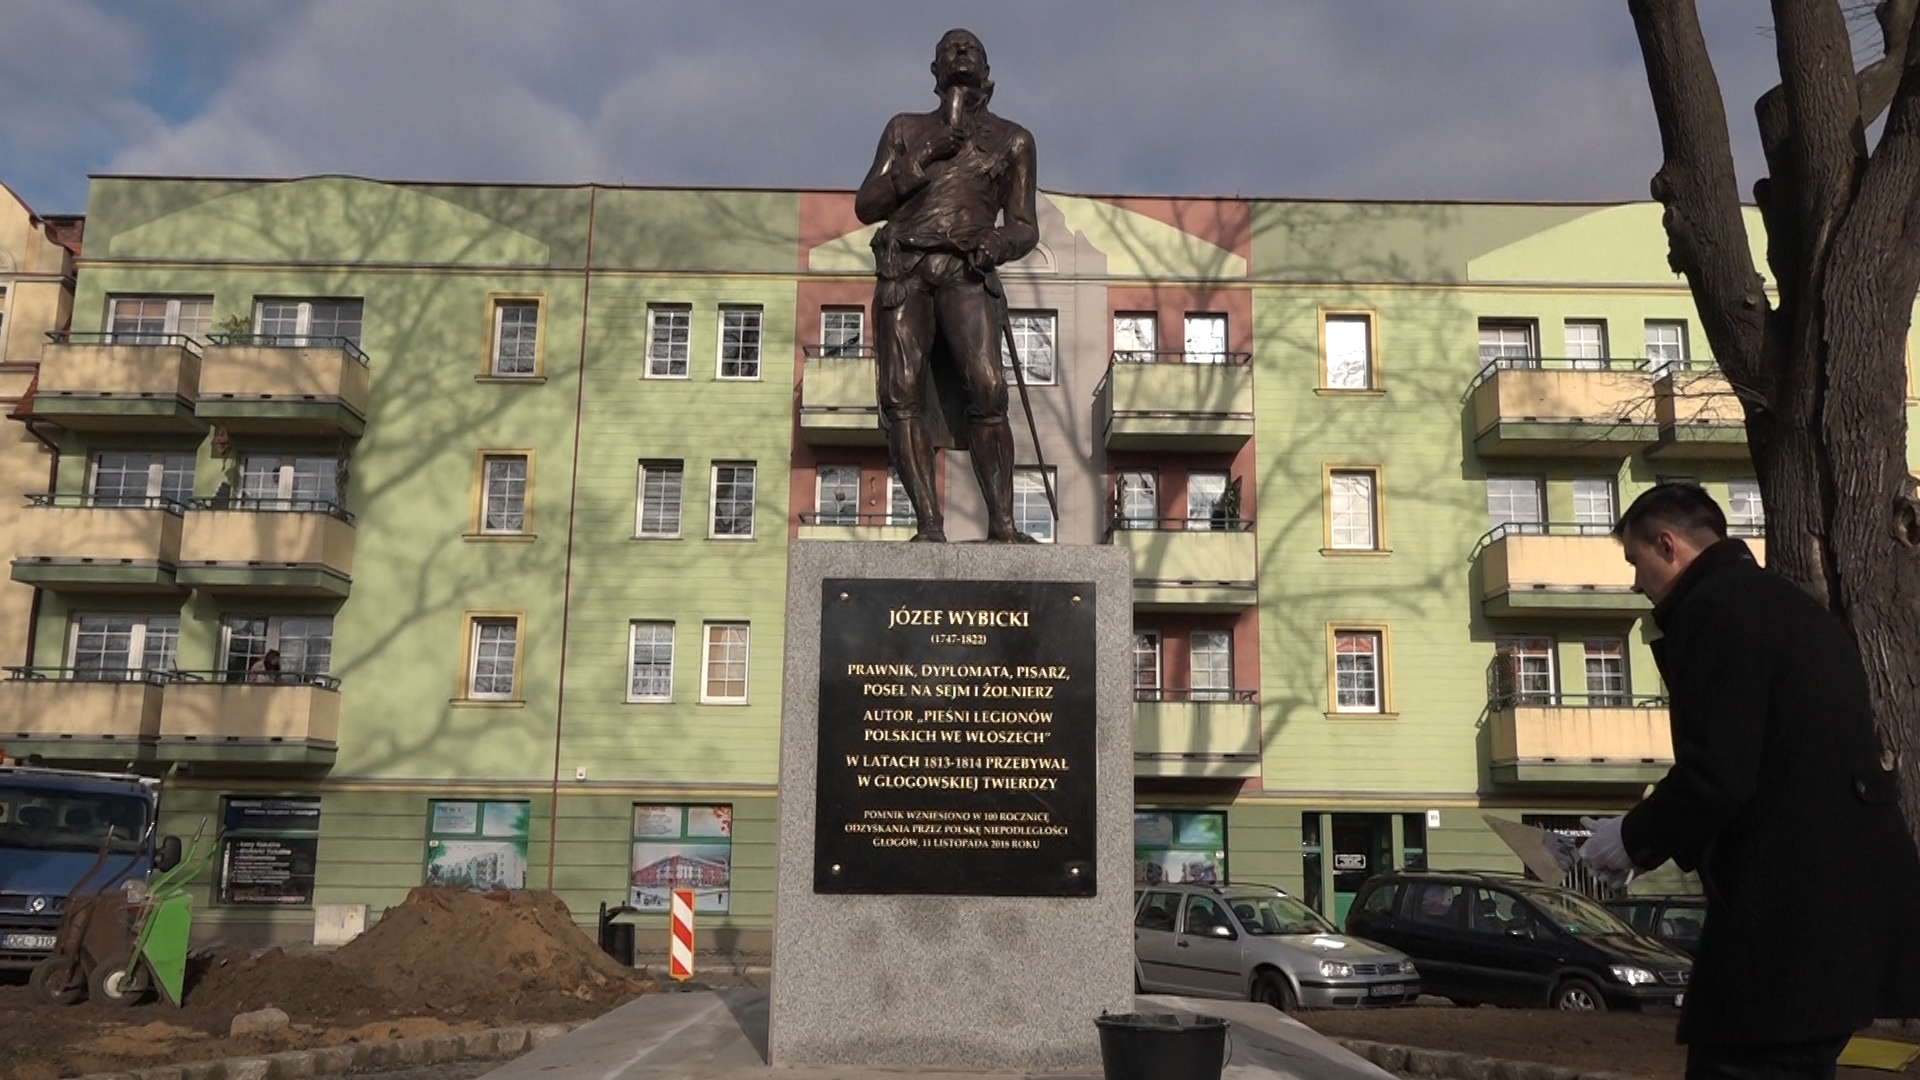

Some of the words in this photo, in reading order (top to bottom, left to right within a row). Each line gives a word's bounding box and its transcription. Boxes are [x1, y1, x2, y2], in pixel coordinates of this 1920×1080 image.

[888, 605, 943, 629] JÓZEF
[948, 610, 1029, 627] WYBICKI
[931, 634, 986, 645] (1747-1822)
[848, 663, 918, 678] PRAWNIK,
[921, 663, 1013, 680] DYPLOMATA,
[1017, 666, 1070, 681] PISARZ,
[864, 683, 907, 696] POSEŁ
[911, 684, 932, 697] NA
[935, 684, 970, 700] SEJM
[974, 685, 978, 697] I
[982, 683, 1053, 699] ŻOŁNIERZ
[863, 709, 913, 722] AUTOR
[974, 709, 1053, 724] LEGIONÓW
[865, 729, 936, 742] POLSKICH
[940, 730, 961, 743] WE
[846, 755, 859, 766] W
[863, 755, 920, 768] LATACH
[924, 756, 982, 769] 1813-1814
[986, 756, 1069, 770] PRZEBYWAŁ
[858, 775, 871, 786] W
[874, 775, 978, 792] GŁOGOWSKIEJ
[982, 777, 1057, 790] TWIERDZY
[863, 809, 905, 820] POMNIK
[906, 810, 971, 821] WZNIESIONO
[972, 812, 983, 821] W
[984, 812, 999, 822] 100
[999, 812, 1050, 825] ROCZNICĘ
[844, 823, 911, 834] ODZYSKANIA
[912, 823, 943, 834] PRZEZ
[944, 824, 982, 837] POLSKĘ
[983, 824, 1068, 836] NIEPODLEGŁOŚCI
[922, 838, 932, 847] 11
[933, 838, 989, 849] LISTOPADA
[990, 839, 1010, 849] 2018
[1011, 838, 1040, 850] ROKU
